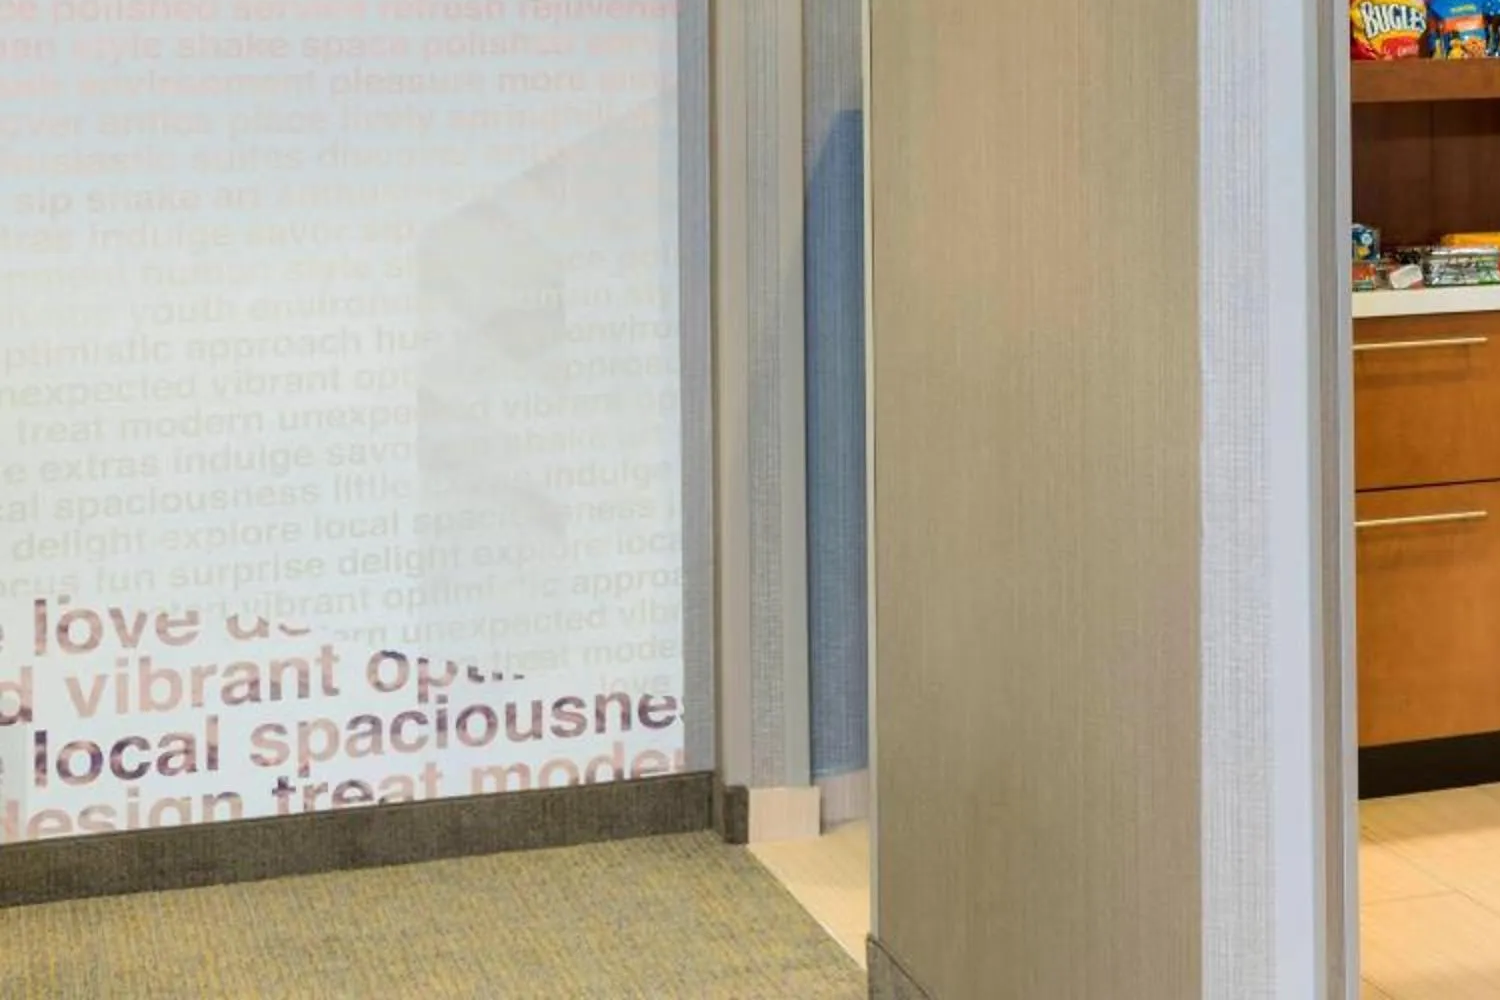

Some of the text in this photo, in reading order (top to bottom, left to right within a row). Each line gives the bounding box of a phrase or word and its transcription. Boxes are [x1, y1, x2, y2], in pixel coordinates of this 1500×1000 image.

[177, 32, 289, 60] shake
[185, 326, 362, 368] approach
[211, 364, 341, 399] vibrant
[17, 415, 104, 446] treat
[120, 409, 264, 440] modern
[39, 453, 160, 483] extras
[173, 444, 314, 478] indulge
[52, 480, 321, 526] spaciousness
[11, 525, 147, 562] delight
[160, 516, 302, 553] explore
[313, 509, 399, 542] local
[170, 552, 325, 591] surprise
[338, 543, 462, 582] delight
[34, 598, 199, 657] love
[402, 604, 608, 646] unexpected
[64, 643, 341, 718] vibrant
[34, 691, 678, 787] local spaciousne
[272, 761, 442, 812] treat
